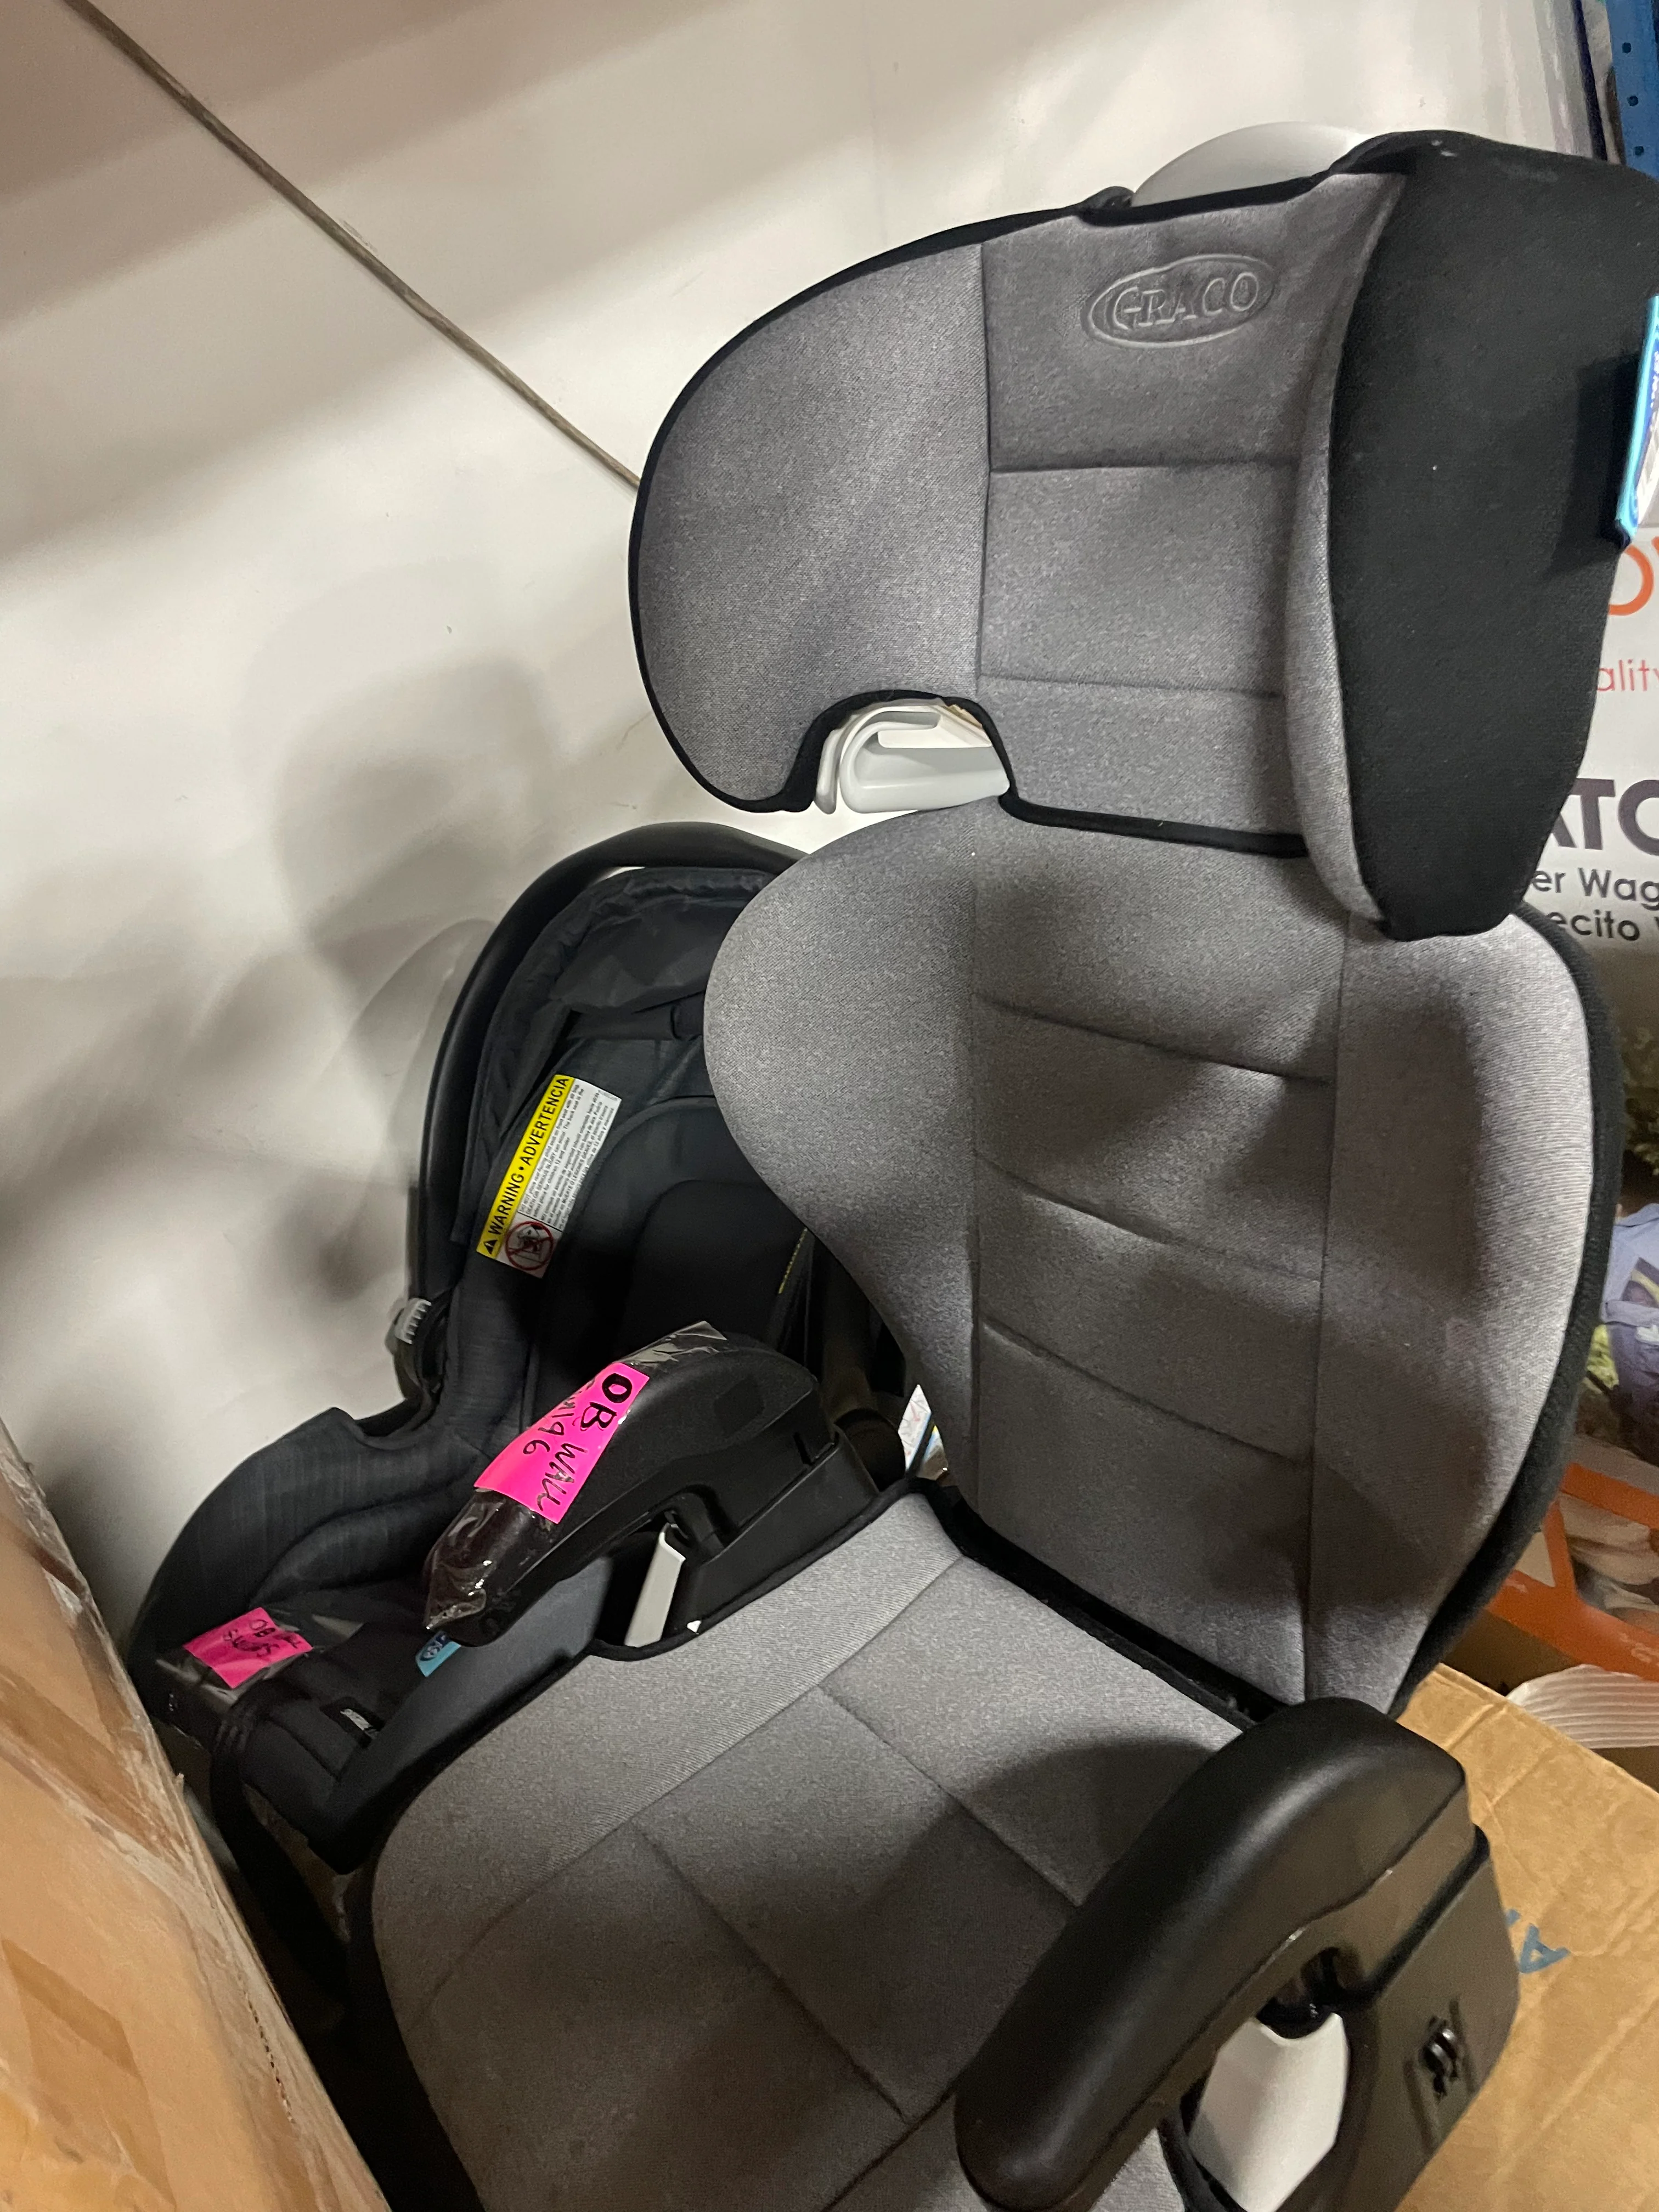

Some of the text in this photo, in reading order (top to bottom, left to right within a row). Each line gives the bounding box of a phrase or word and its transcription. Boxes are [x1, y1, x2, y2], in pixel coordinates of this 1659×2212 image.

[1113, 272, 1259, 330] GRACO
[489, 1173, 524, 1235] WARNING
[522, 1077, 569, 1166] ADVERTENCIA
[580, 1373, 633, 1430] OB
